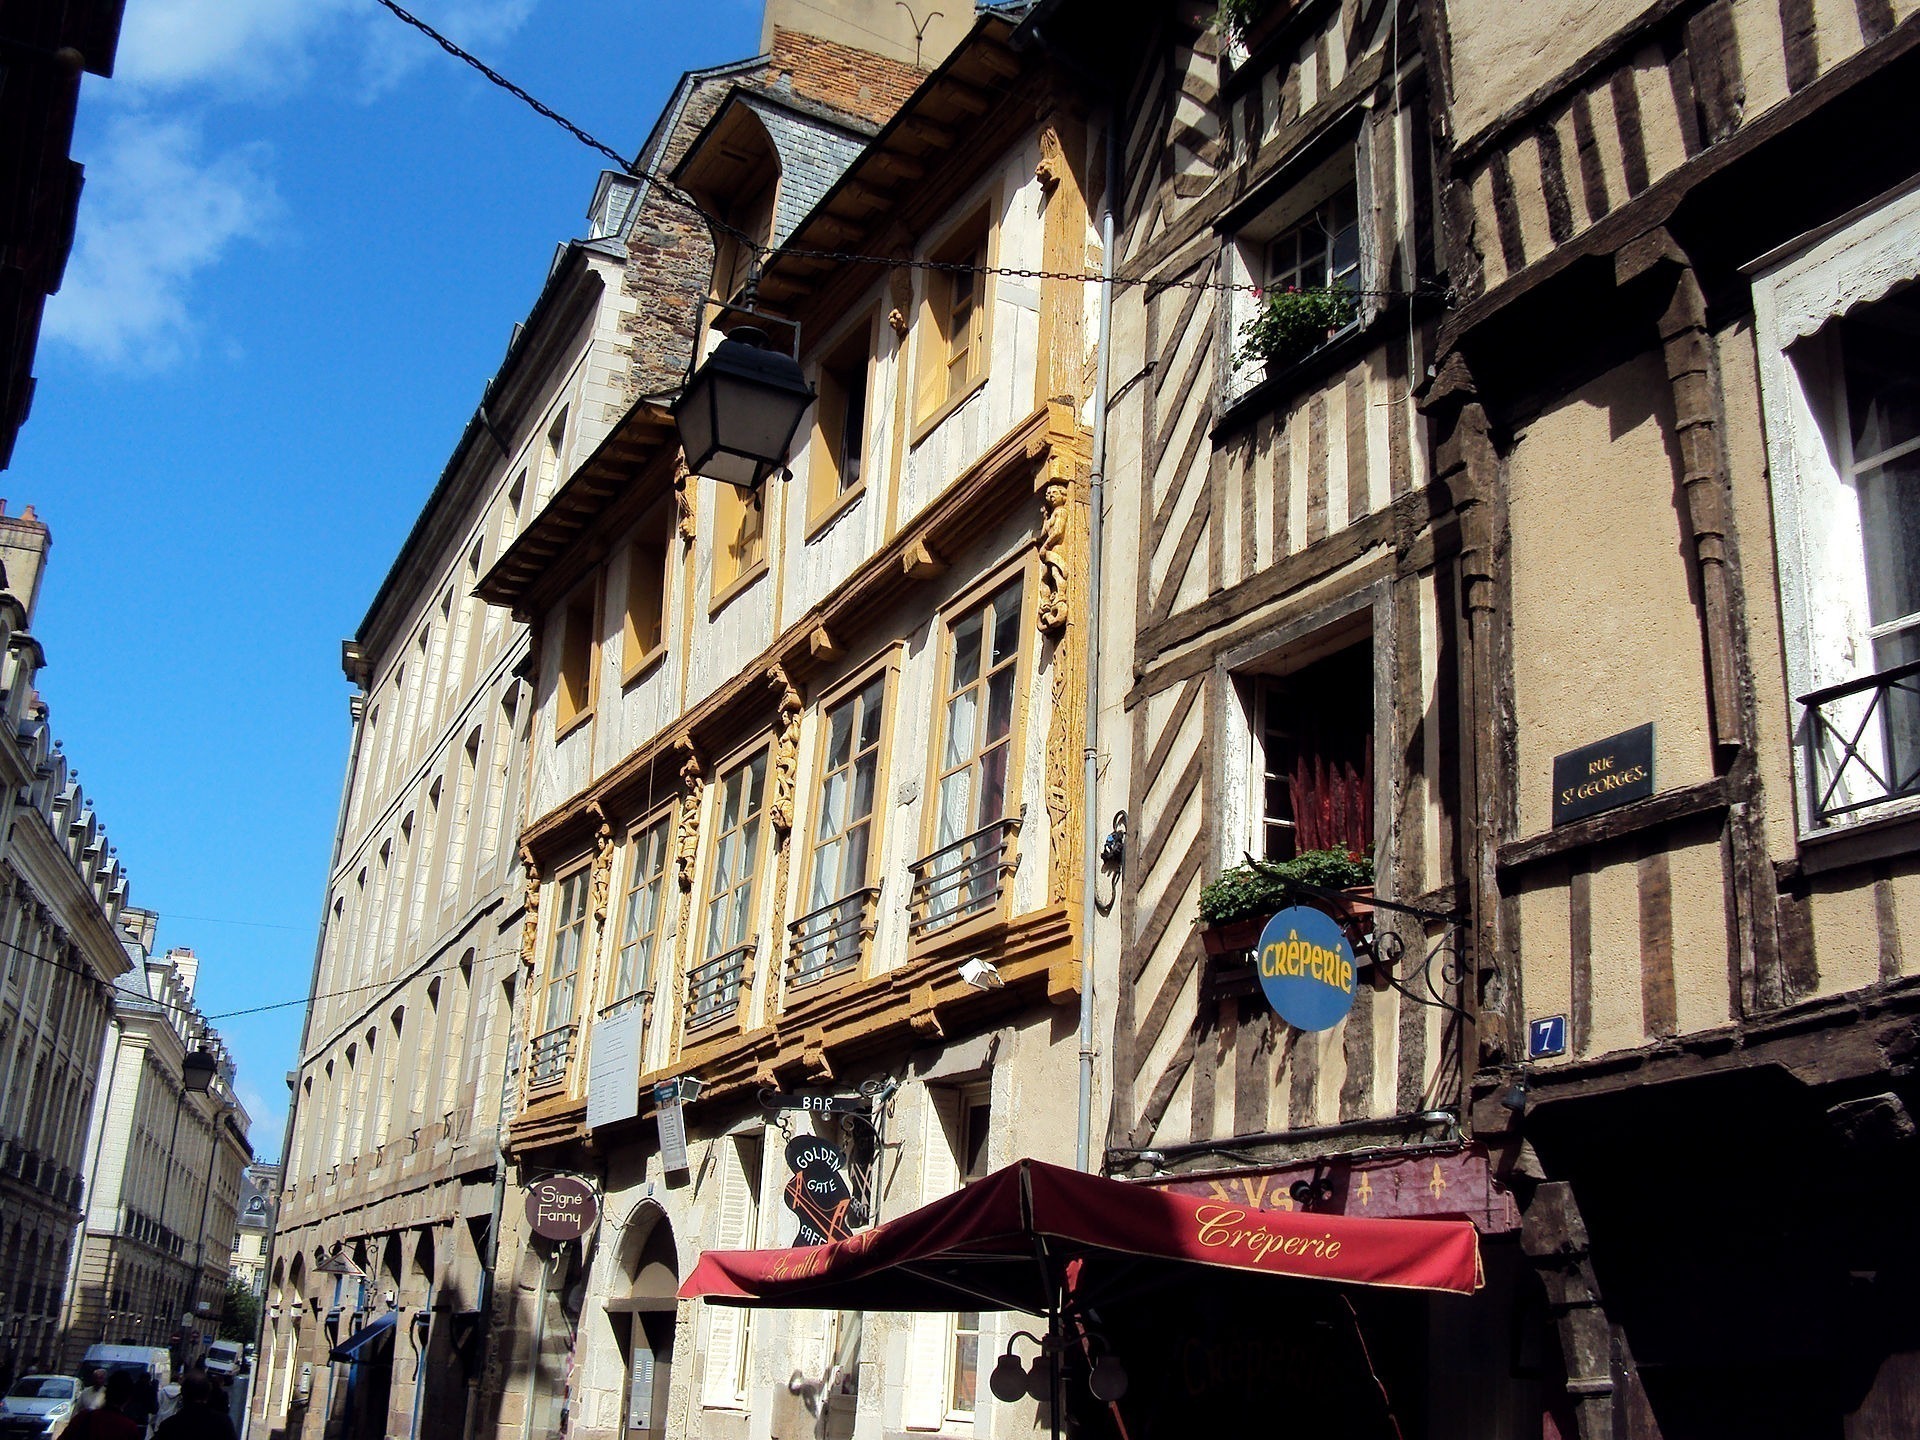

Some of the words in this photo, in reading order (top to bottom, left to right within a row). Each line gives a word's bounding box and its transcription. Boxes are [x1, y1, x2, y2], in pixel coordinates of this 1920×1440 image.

[1588, 755, 1616, 776] RUE
[1539, 1021, 1554, 1051] 7
[803, 1096, 834, 1111] BAR
[796, 1147, 841, 1173] GOLDEN
[541, 1185, 583, 1209] Signé
[807, 1178, 837, 1194] GATE
[537, 1204, 581, 1230] Fanny
[1194, 1204, 1342, 1264] Crêperie
